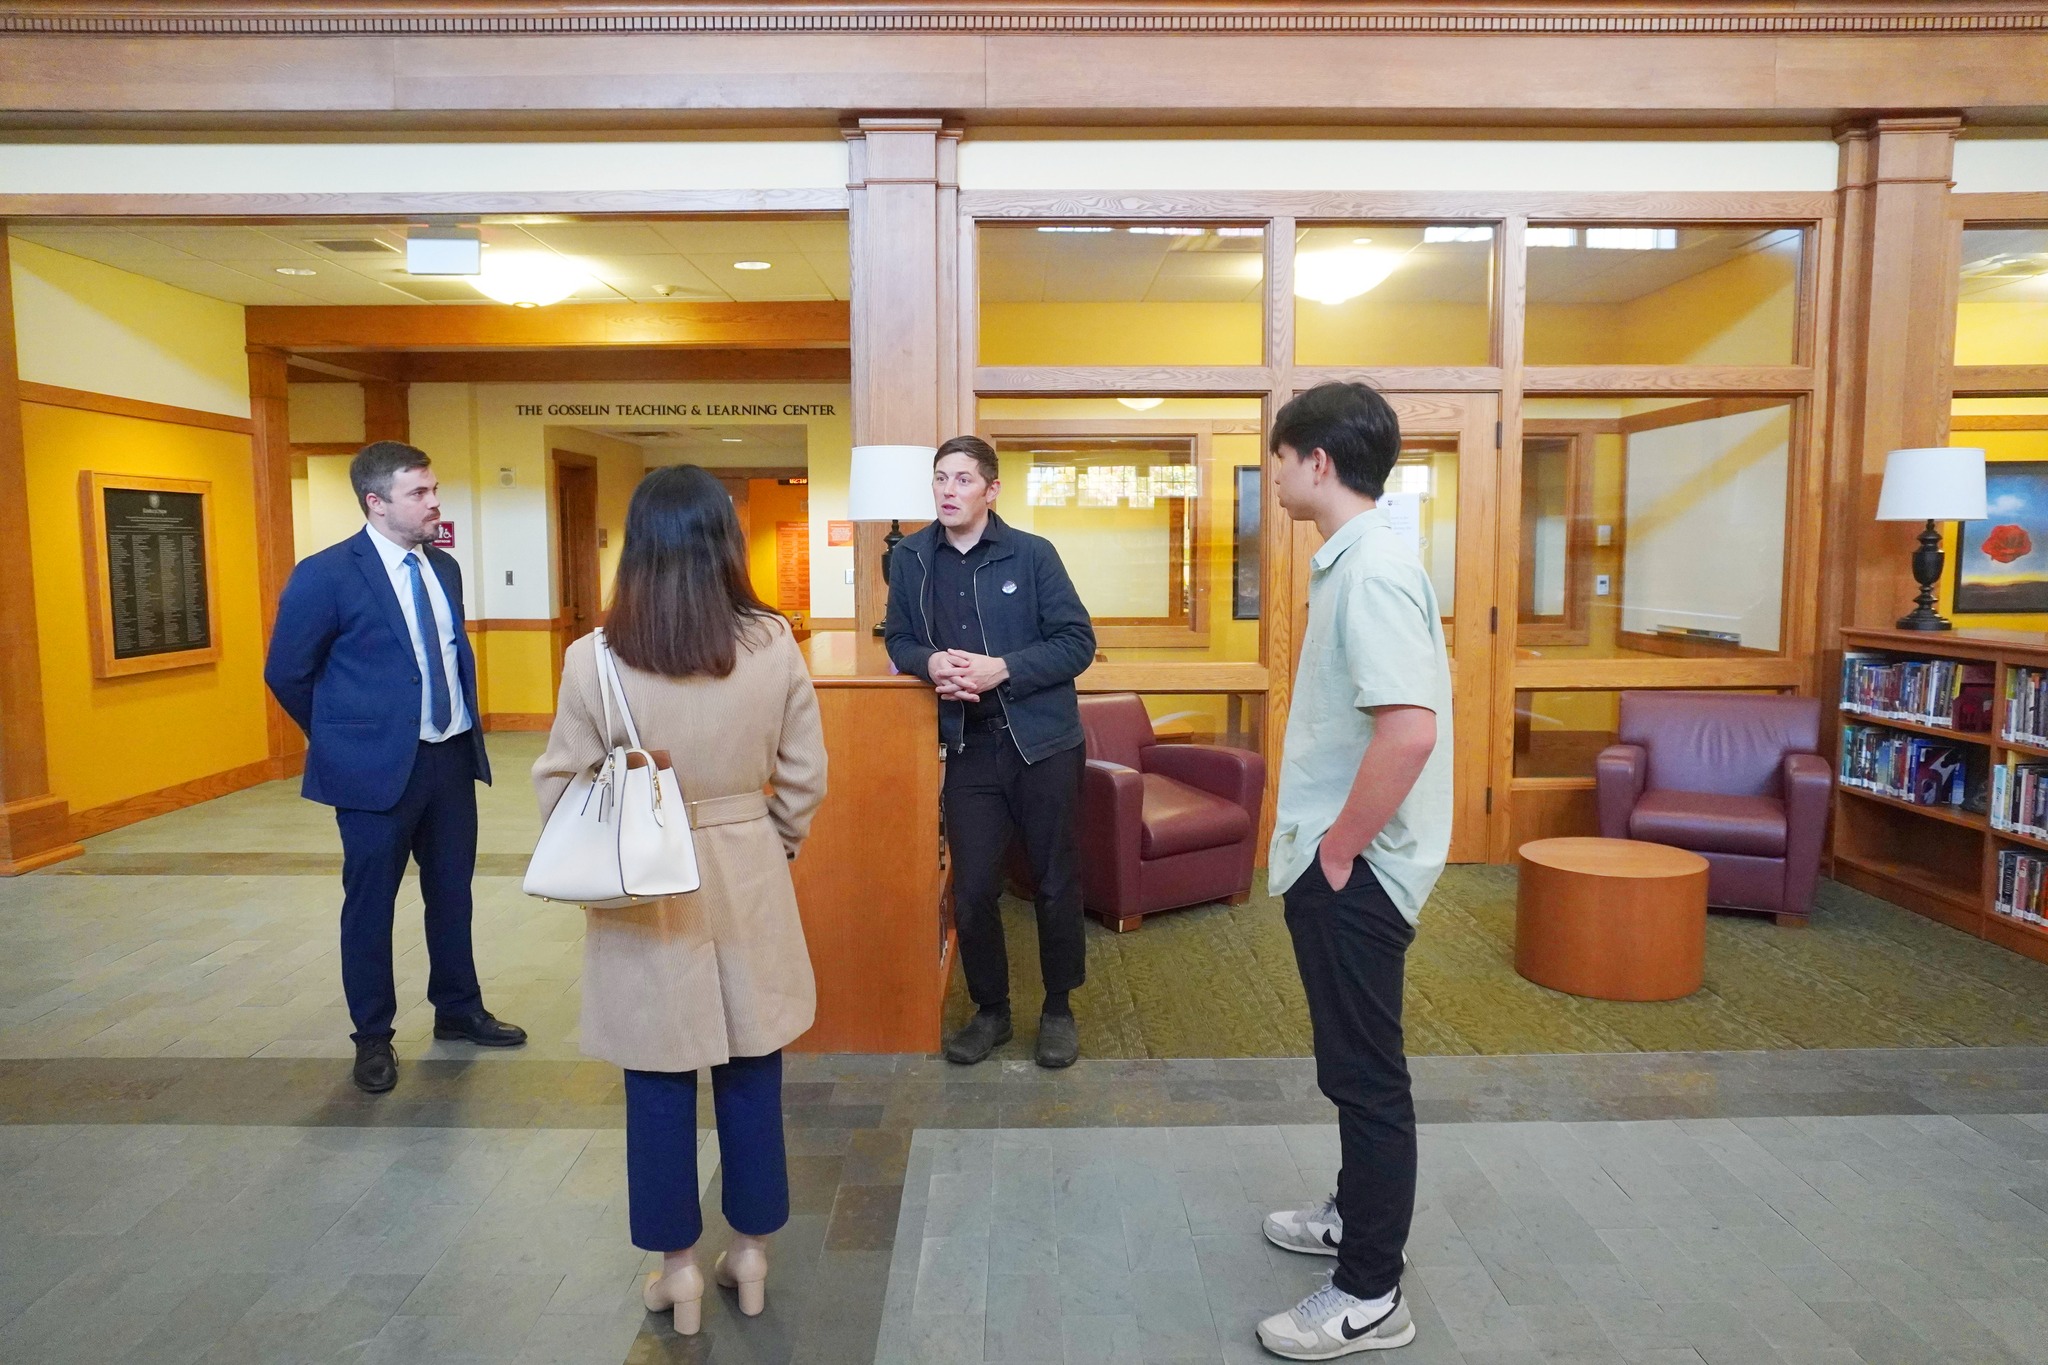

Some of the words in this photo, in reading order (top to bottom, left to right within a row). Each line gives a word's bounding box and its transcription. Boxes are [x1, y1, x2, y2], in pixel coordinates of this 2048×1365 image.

[515, 404, 543, 416] THE
[547, 404, 610, 416] GOSSELIN
[615, 404, 687, 416] TEACHING
[690, 404, 702, 416] &
[706, 404, 778, 416] LEARNING
[782, 404, 836, 416] CENTER
